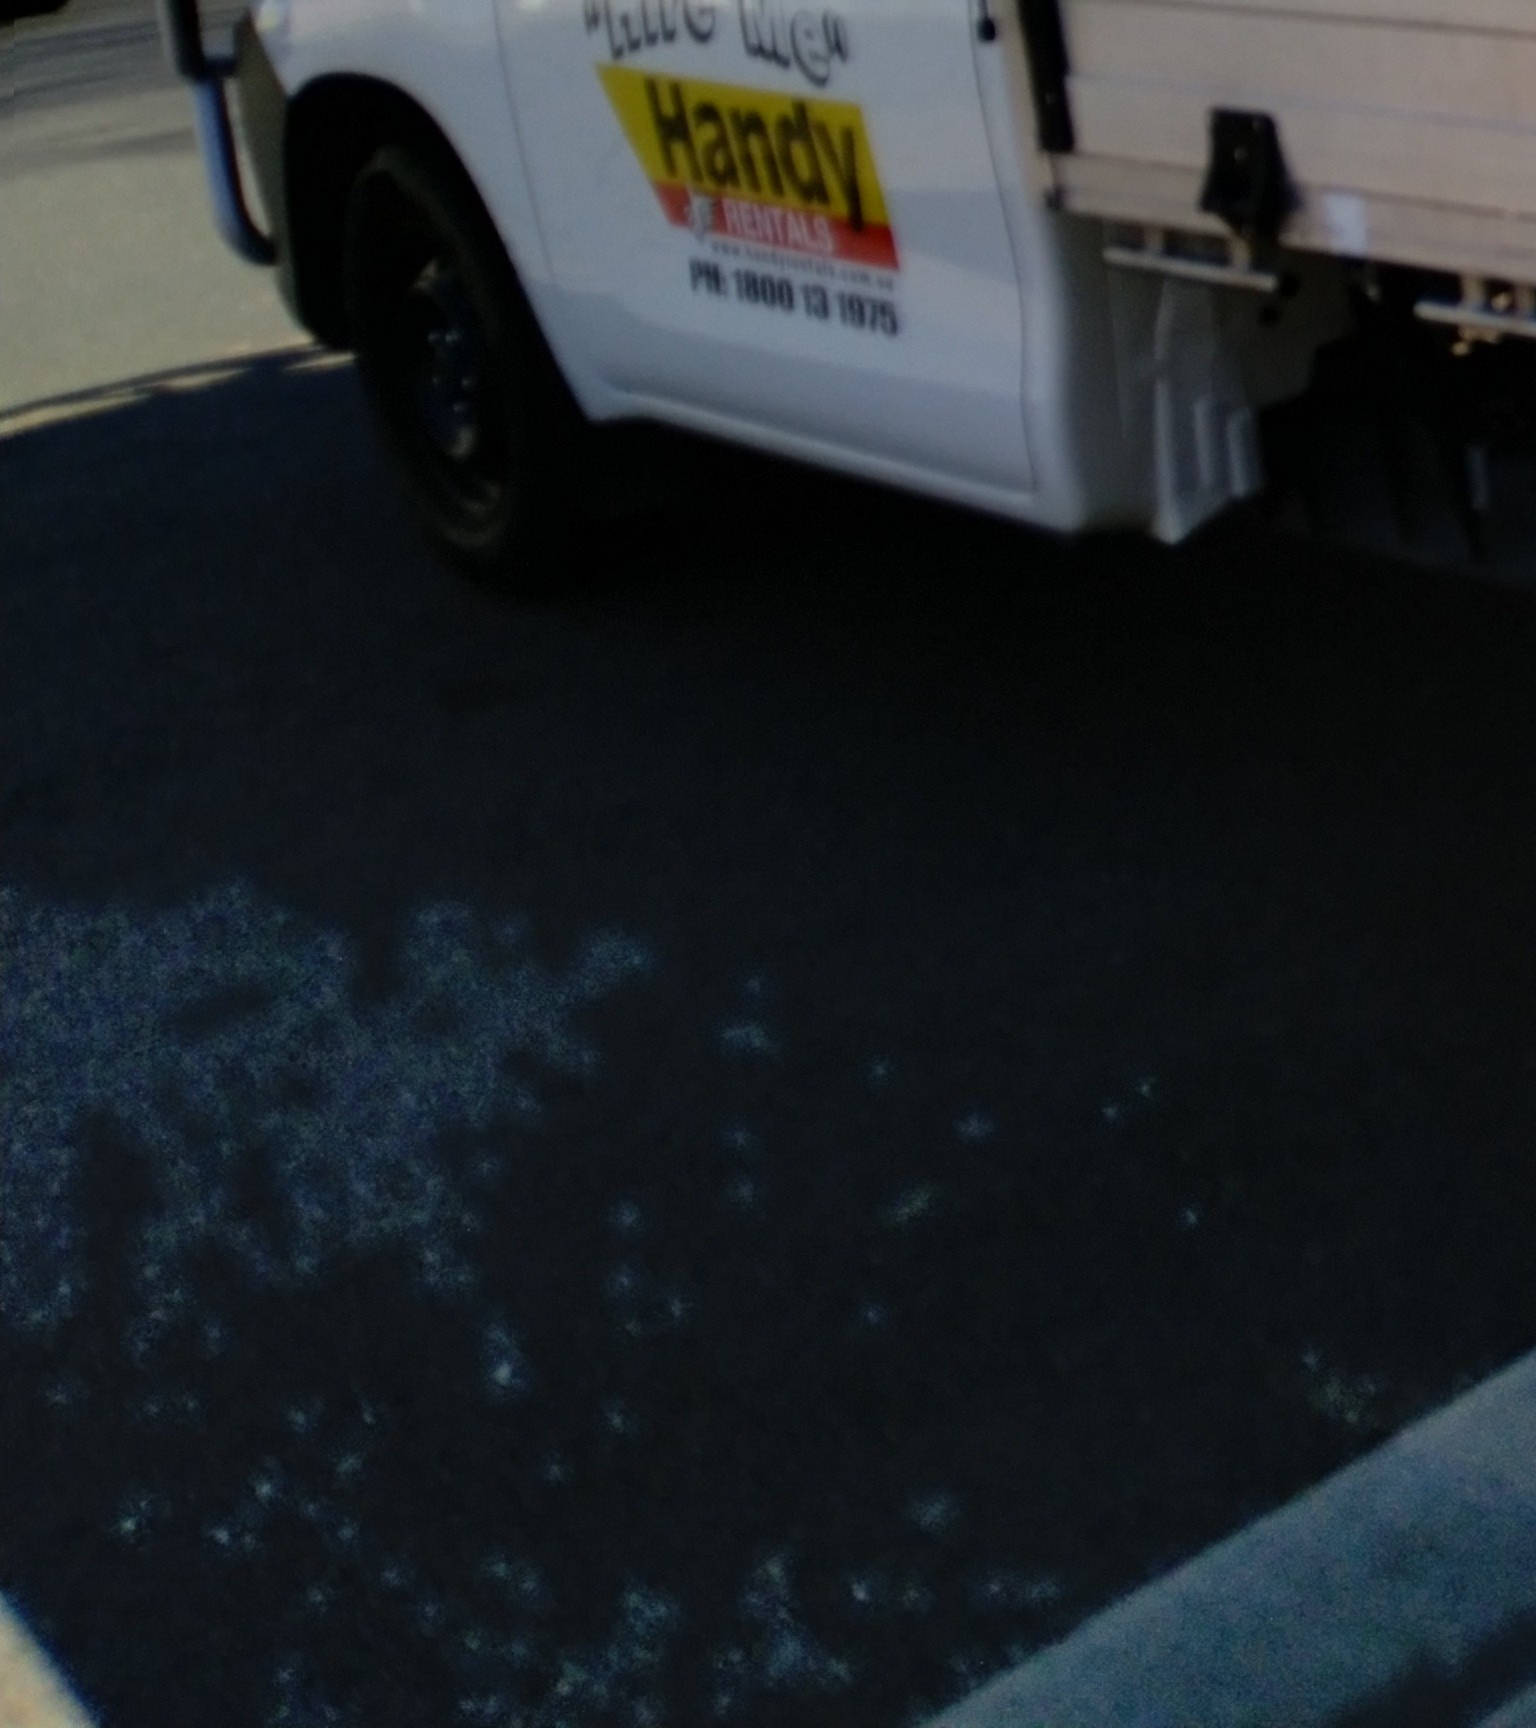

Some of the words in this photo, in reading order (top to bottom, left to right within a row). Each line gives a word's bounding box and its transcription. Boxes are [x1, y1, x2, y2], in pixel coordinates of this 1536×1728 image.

[643, 75, 865, 233] Handy
[721, 195, 835, 254] RENTALS
[734, 268, 796, 312] 1800
[802, 283, 830, 321] 13
[839, 291, 899, 337] 1975
